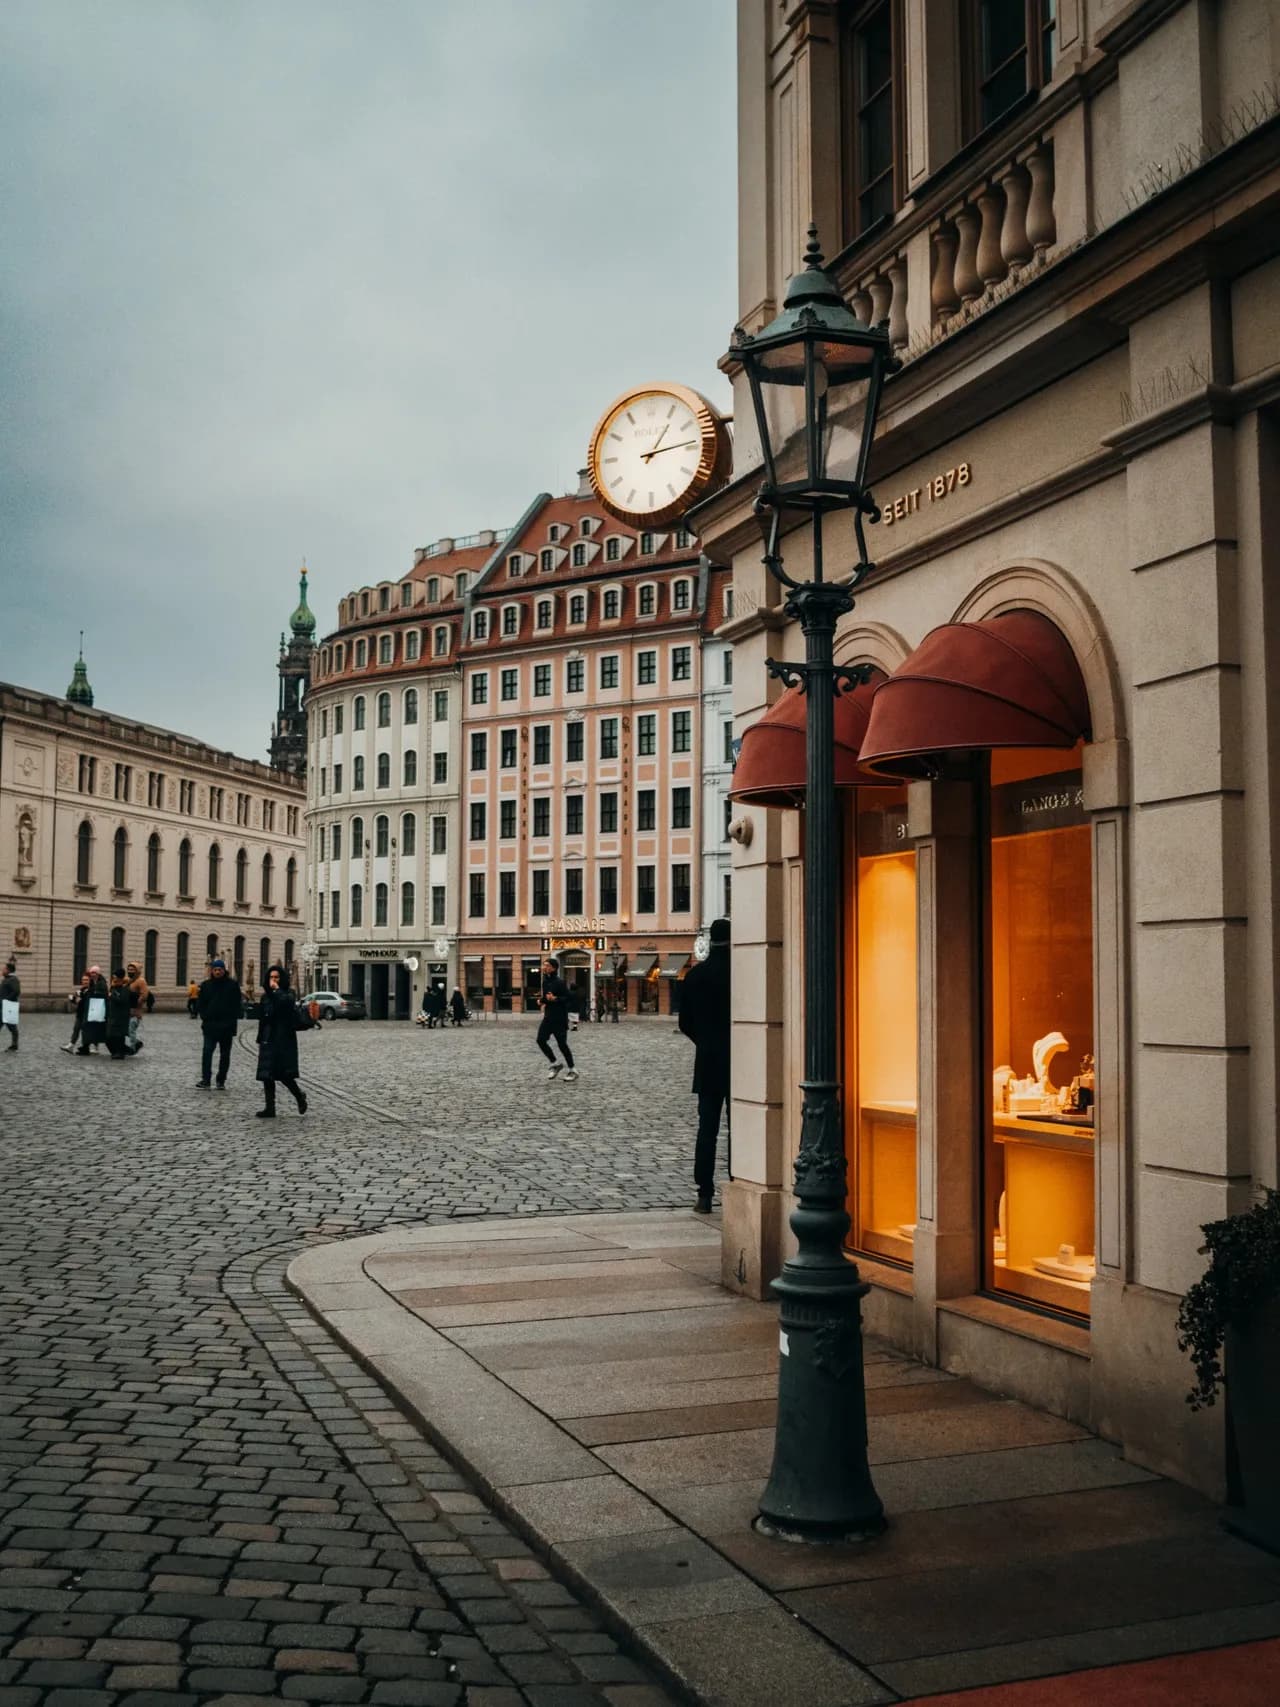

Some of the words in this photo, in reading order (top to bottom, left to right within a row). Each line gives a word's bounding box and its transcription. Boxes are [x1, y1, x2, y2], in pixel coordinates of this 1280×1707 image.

[883, 488, 920, 525] SEIT
[926, 463, 971, 501] 1878
[1022, 792, 1070, 813] LANGE
[549, 918, 606, 933] PASSAGE
